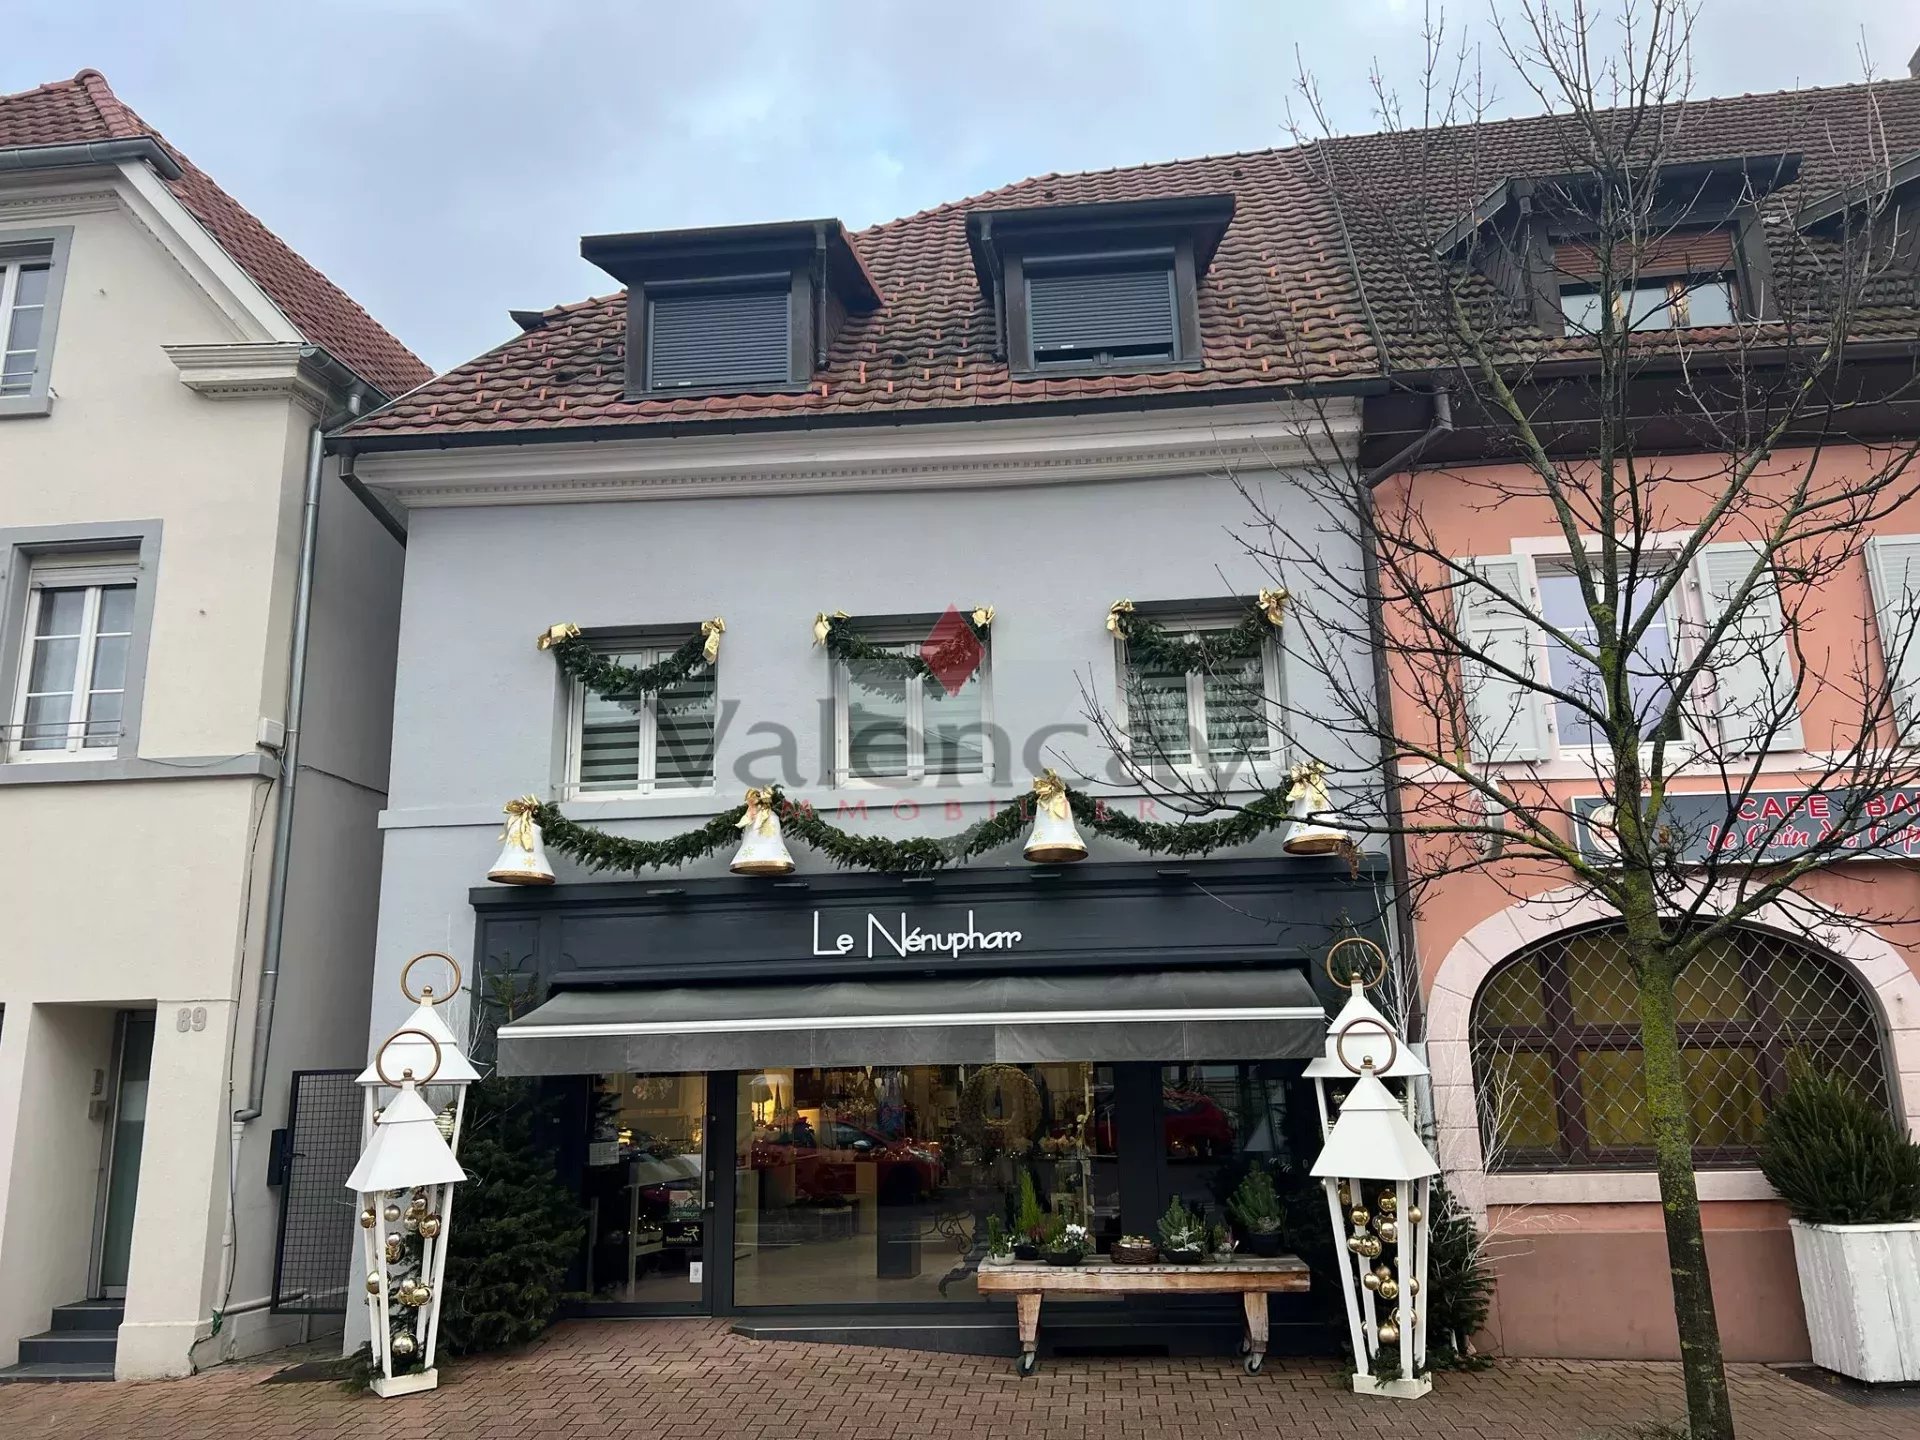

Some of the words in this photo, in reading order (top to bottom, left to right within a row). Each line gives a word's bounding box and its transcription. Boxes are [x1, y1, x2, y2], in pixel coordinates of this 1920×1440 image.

[1737, 795, 1831, 821] CAFE
[813, 910, 854, 956] Le
[867, 909, 1022, 958] Nénuphar
[177, 1007, 207, 1033] 89
